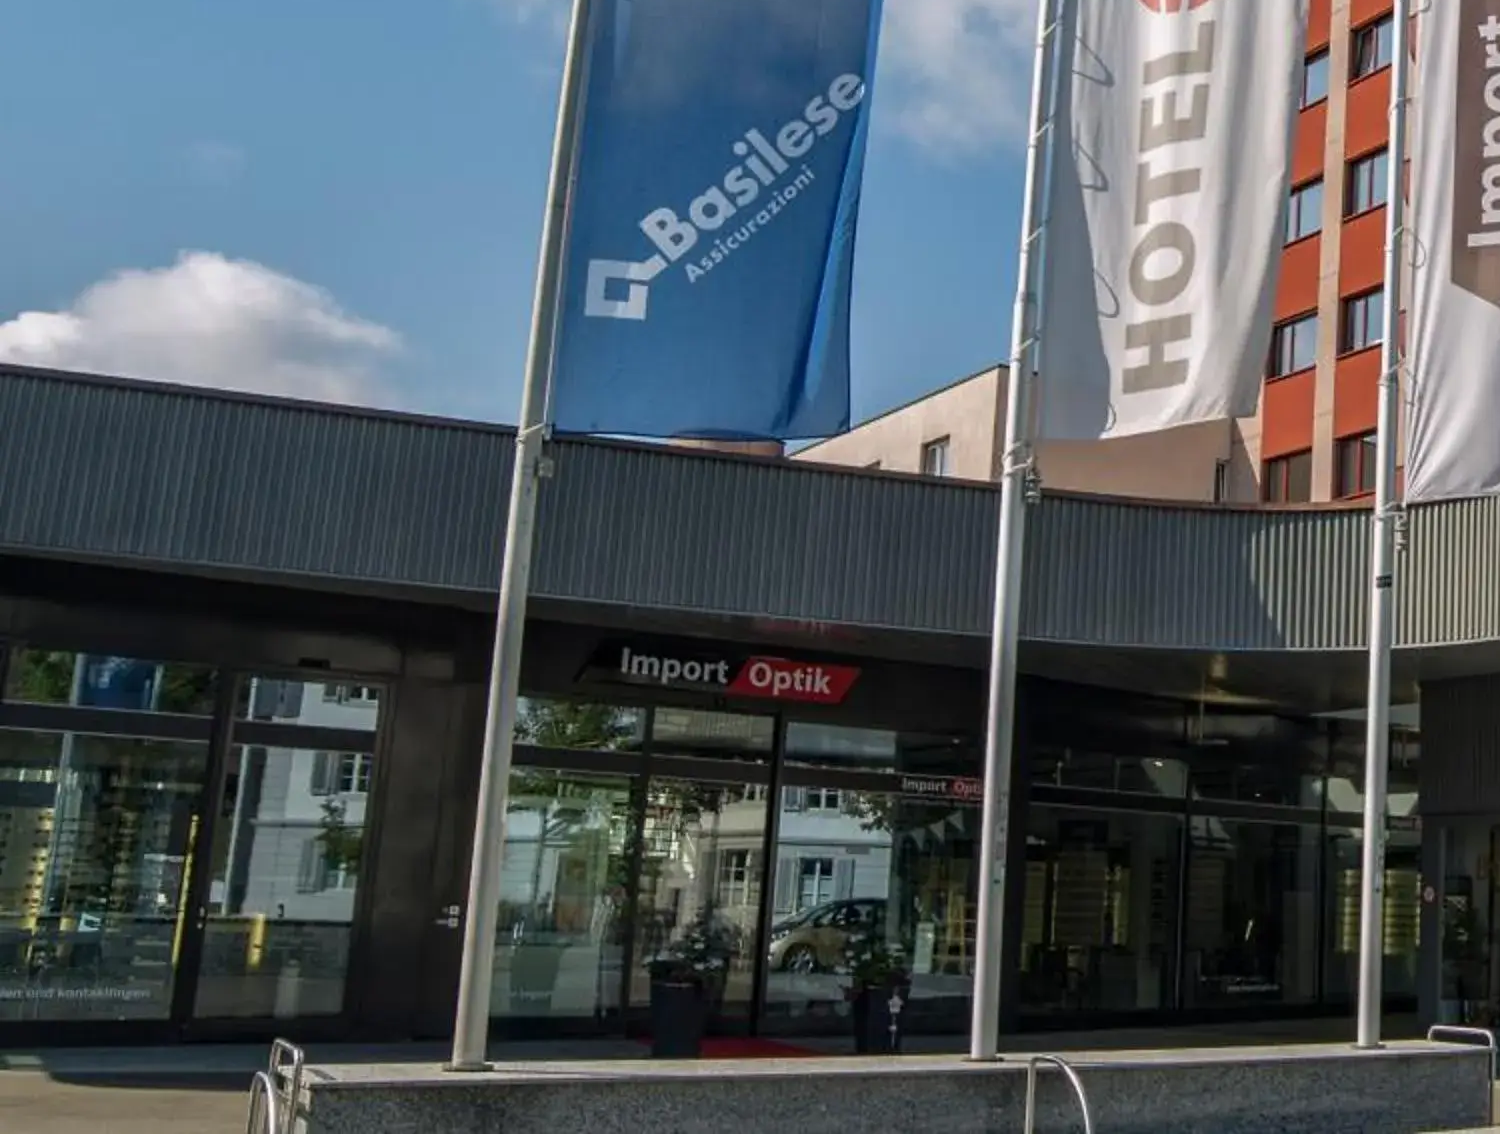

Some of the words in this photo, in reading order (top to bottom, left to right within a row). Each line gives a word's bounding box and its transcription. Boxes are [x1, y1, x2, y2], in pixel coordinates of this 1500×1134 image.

[638, 73, 865, 261] Basilese
[683, 165, 815, 283] Assicurazioni
[1122, 20, 1215, 395] HOTEL
[620, 646, 729, 685] Import
[749, 662, 833, 697] Optik
[902, 777, 947, 793] Import
[953, 780, 983, 798] Opti
